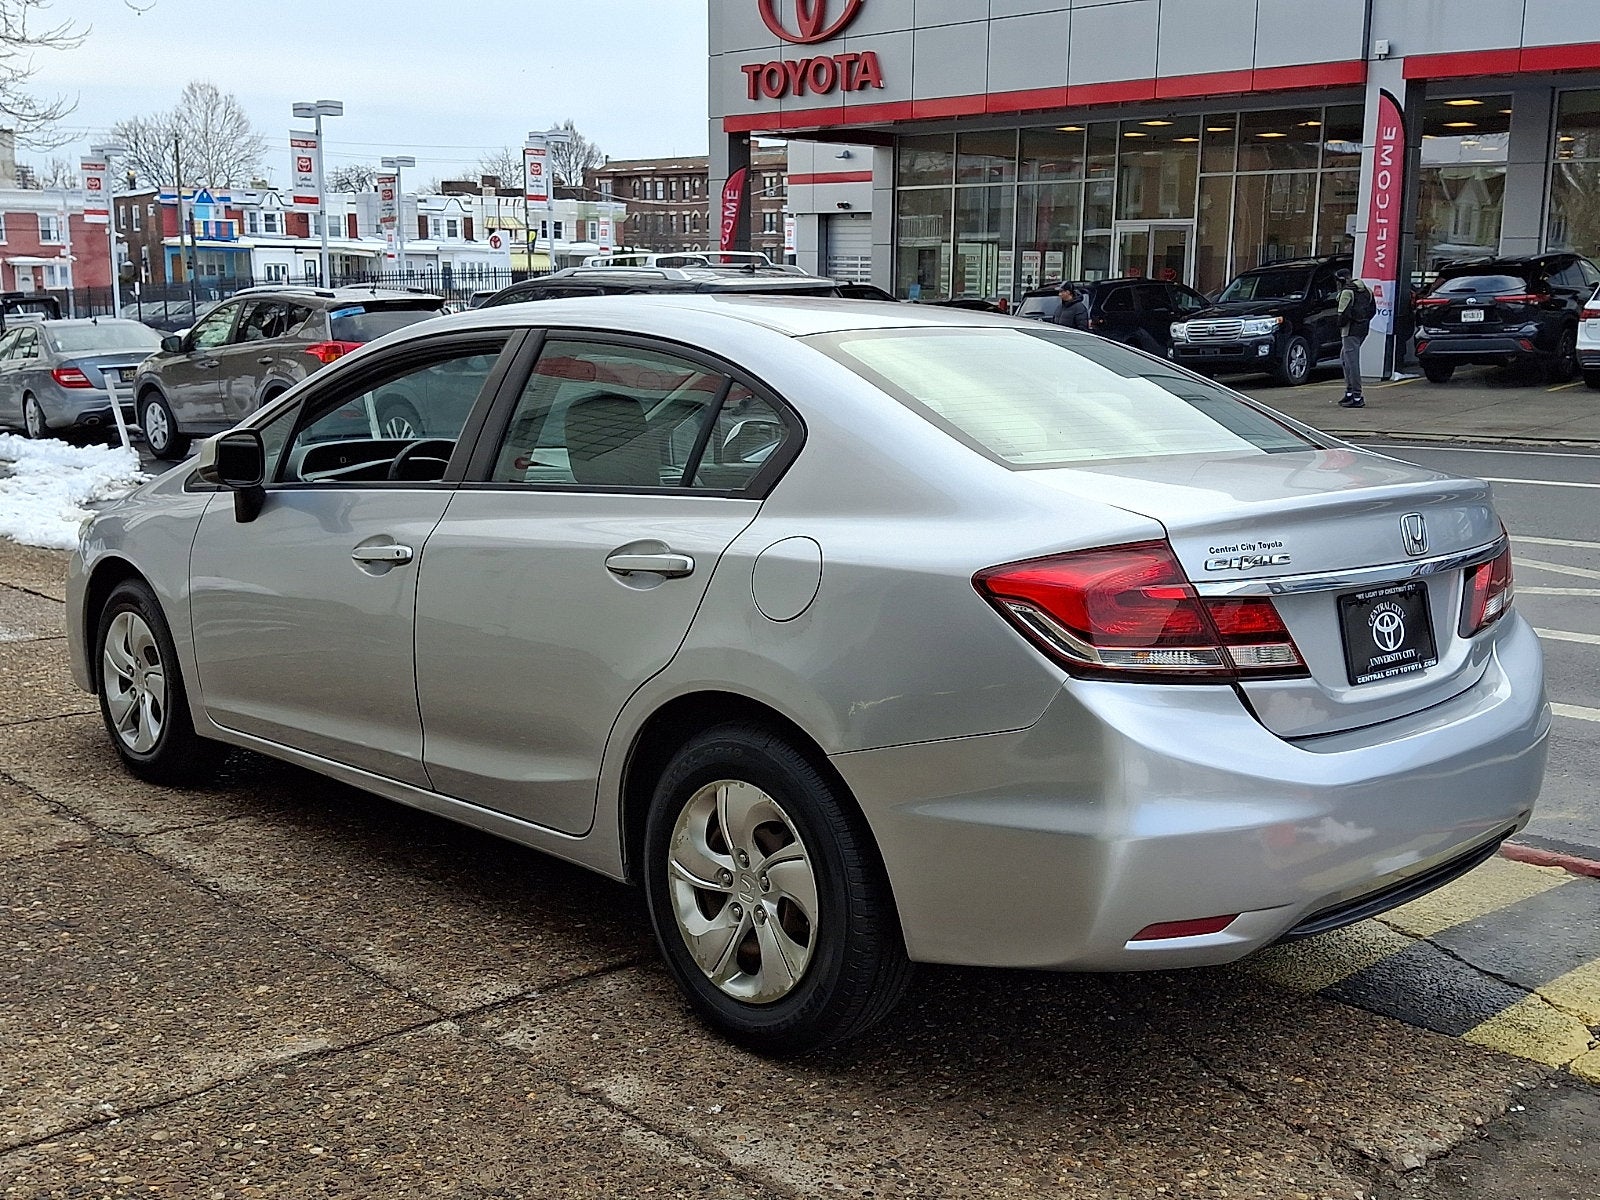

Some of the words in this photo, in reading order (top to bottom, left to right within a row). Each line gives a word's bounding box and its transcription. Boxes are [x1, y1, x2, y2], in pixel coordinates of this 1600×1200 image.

[741, 51, 884, 100] TOYOTA
[1209, 545, 1239, 554] Central
[1240, 543, 1256, 551] City
[1258, 541, 1283, 550] Toyota
[1204, 553, 1291, 571] CIVIC
[1368, 601, 1391, 627] CENTRAL
[1391, 603, 1406, 619] CITY
[1370, 652, 1403, 666] UNIVERSITY
[1402, 648, 1416, 659] CITY
[1357, 672, 1385, 683] CENTRAL
[1385, 668, 1399, 677] CITY
